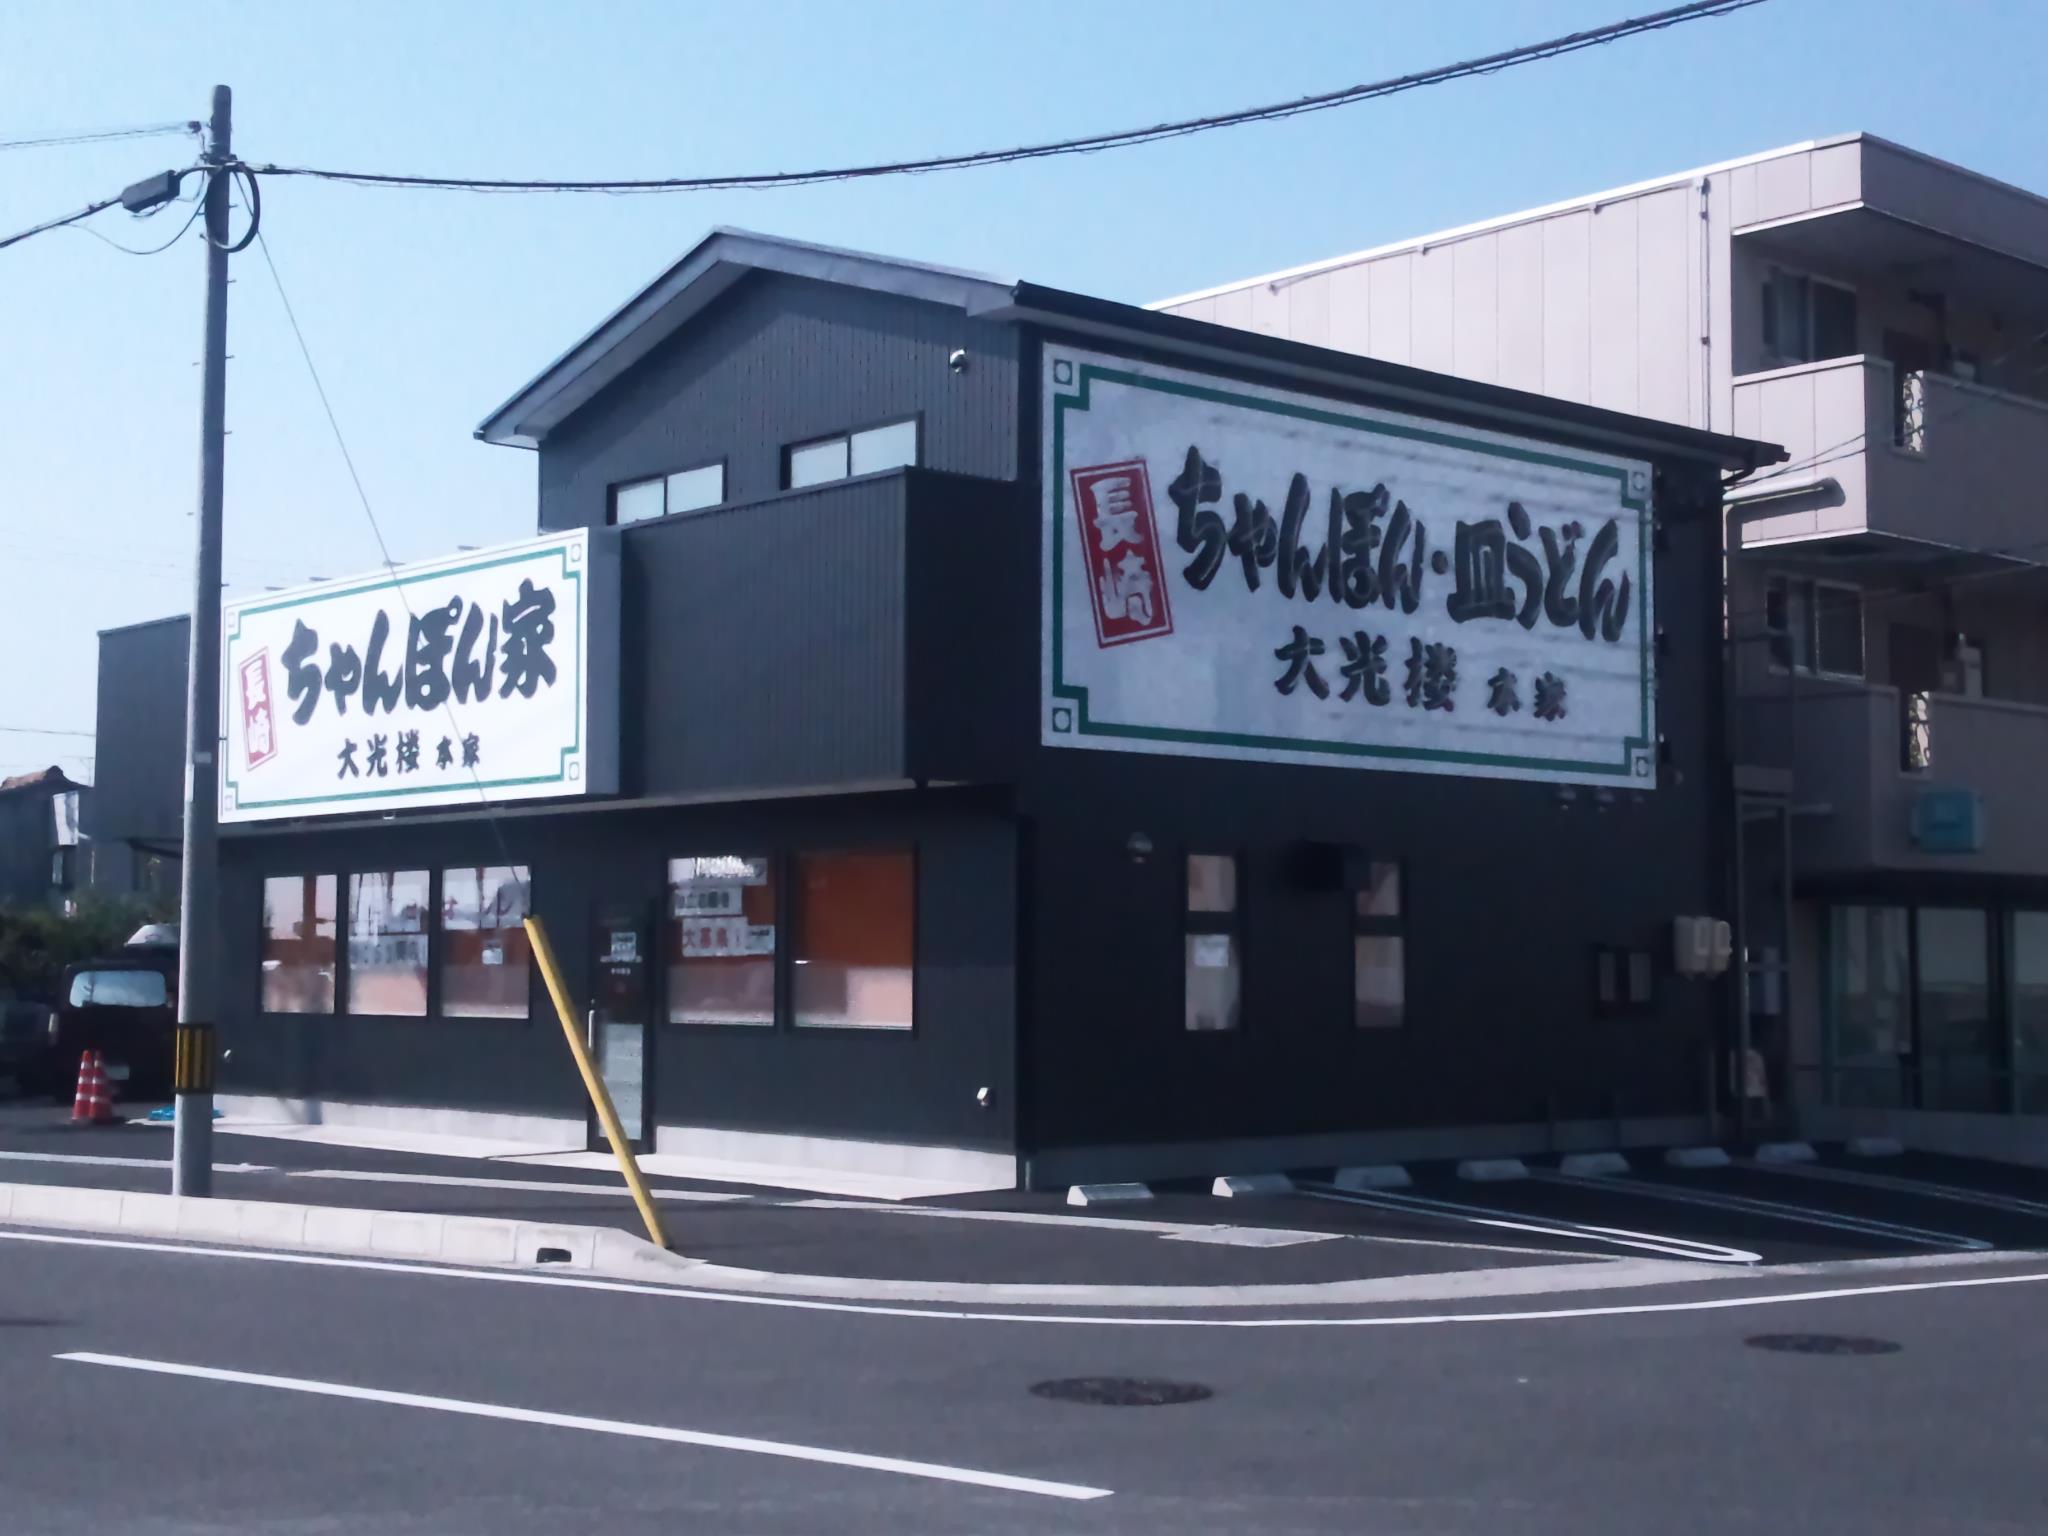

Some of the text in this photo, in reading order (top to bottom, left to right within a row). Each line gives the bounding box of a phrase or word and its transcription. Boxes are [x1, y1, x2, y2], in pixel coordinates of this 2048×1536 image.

[1090, 476, 1152, 627] 長崎
[1168, 445, 1630, 642] ちゃんぽん・皿うどん
[281, 578, 557, 726] ちゃんぽん家
